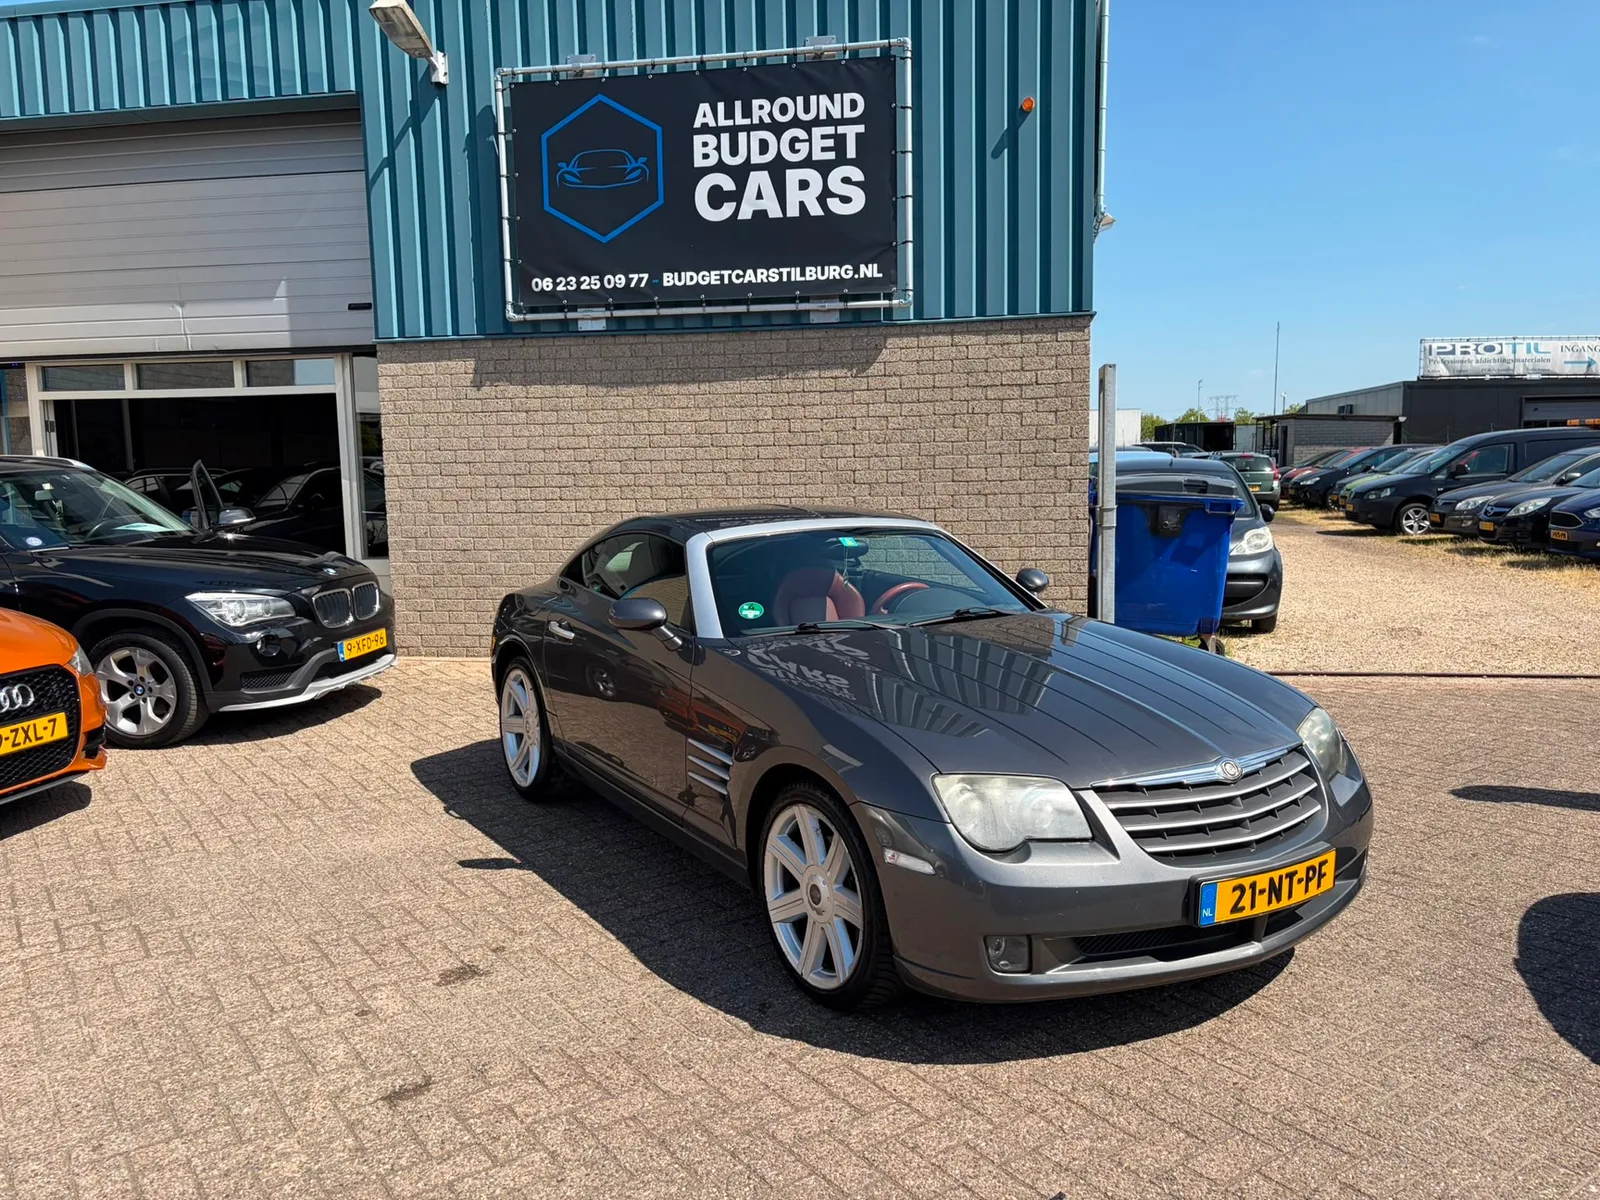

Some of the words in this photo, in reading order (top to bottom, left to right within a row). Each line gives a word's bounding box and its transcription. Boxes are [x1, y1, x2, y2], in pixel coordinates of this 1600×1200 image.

[693, 92, 865, 129] ALLROUND
[693, 124, 866, 168] BUDGET
[694, 166, 866, 222] CARS
[531, 277, 554, 292] 06
[556, 276, 577, 291] 23
[580, 275, 601, 290] 25
[604, 274, 626, 289] 09
[629, 273, 649, 288] 77
[662, 263, 883, 287] BUDGETCARSTILBURG.NL
[1428, 342, 1551, 356] PROTIL
[1475, 356, 1551, 365] afdichtingsmaterialen
[1560, 345, 1600, 353] INGANG
[346, 632, 385, 656] 9-XFD-96
[1230, 859, 1328, 915] 21-NT-PF
[1202, 908, 1213, 918] NL
